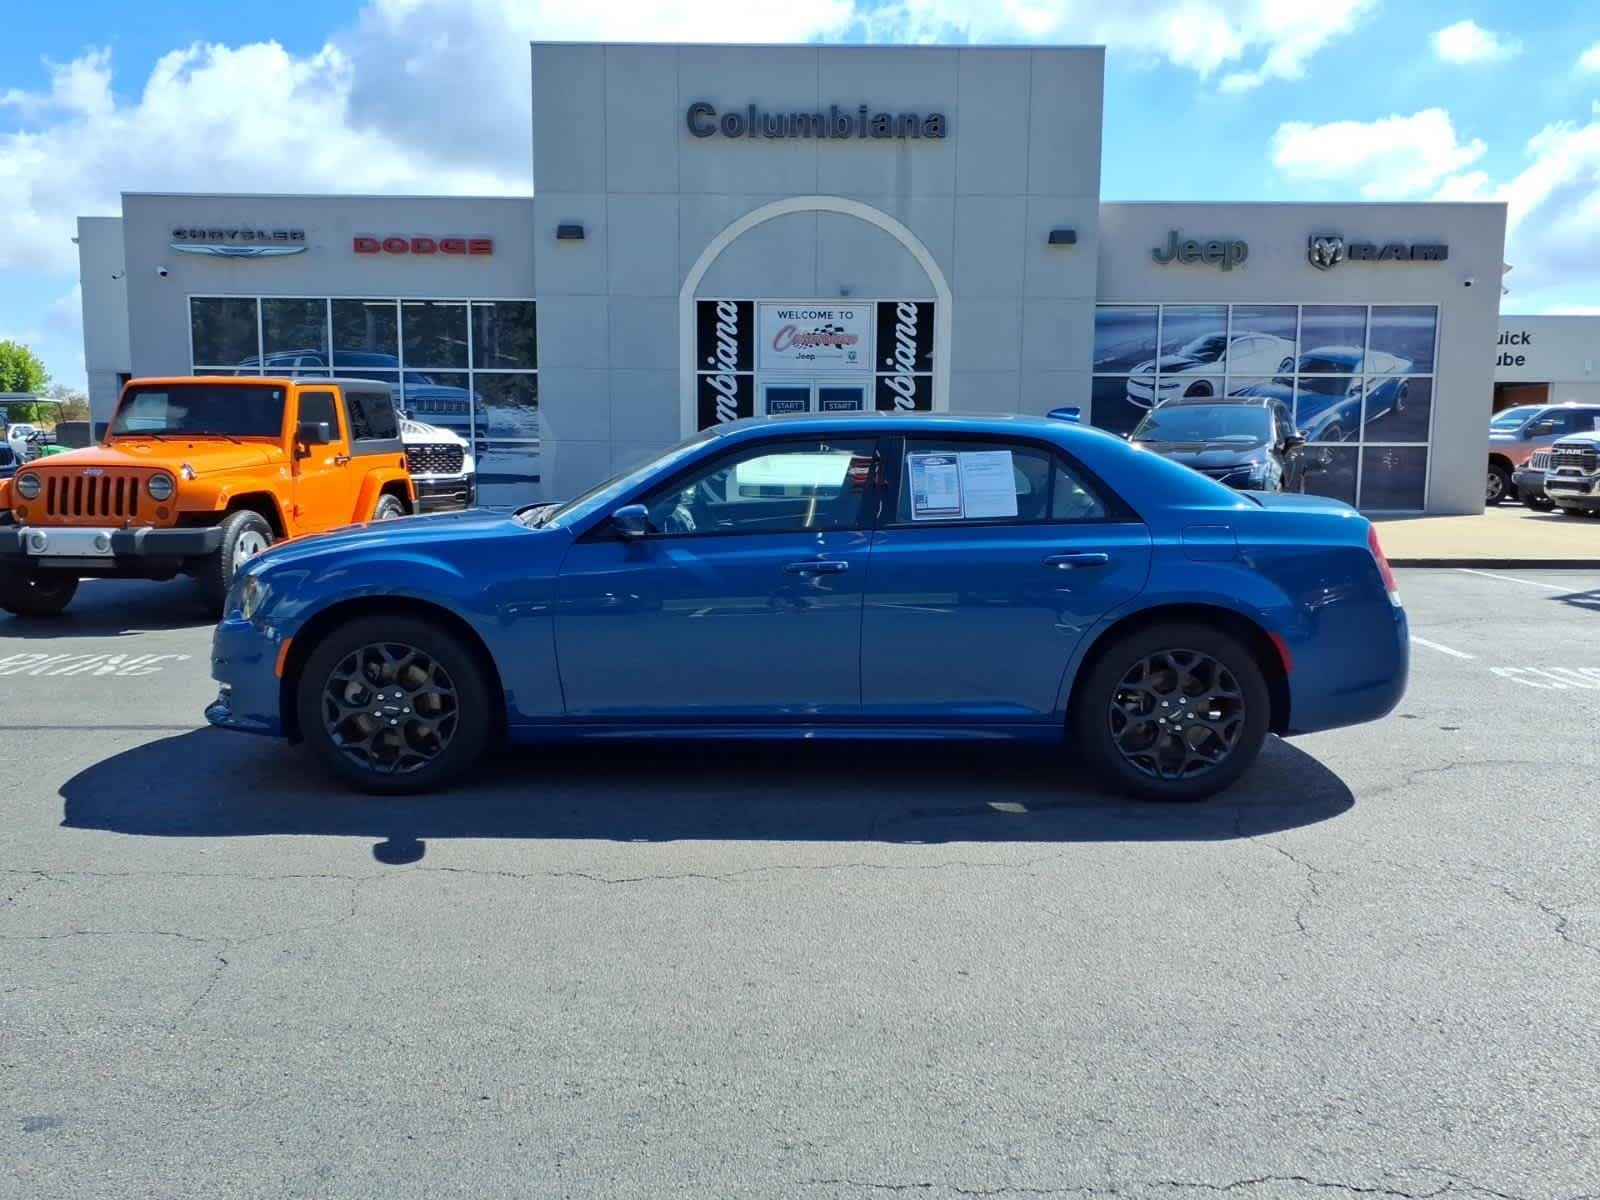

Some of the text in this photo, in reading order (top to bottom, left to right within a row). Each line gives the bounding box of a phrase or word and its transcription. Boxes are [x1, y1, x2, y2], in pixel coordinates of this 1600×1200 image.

[686, 102, 948, 139] Columbiana
[172, 229, 305, 241] CHRYSLER
[353, 237, 493, 255] DODGE
[1152, 230, 1248, 271] Jeep
[1348, 244, 1449, 261] RAM
[777, 311, 854, 320] WELCOME TO
[795, 353, 816, 361] Jeep
